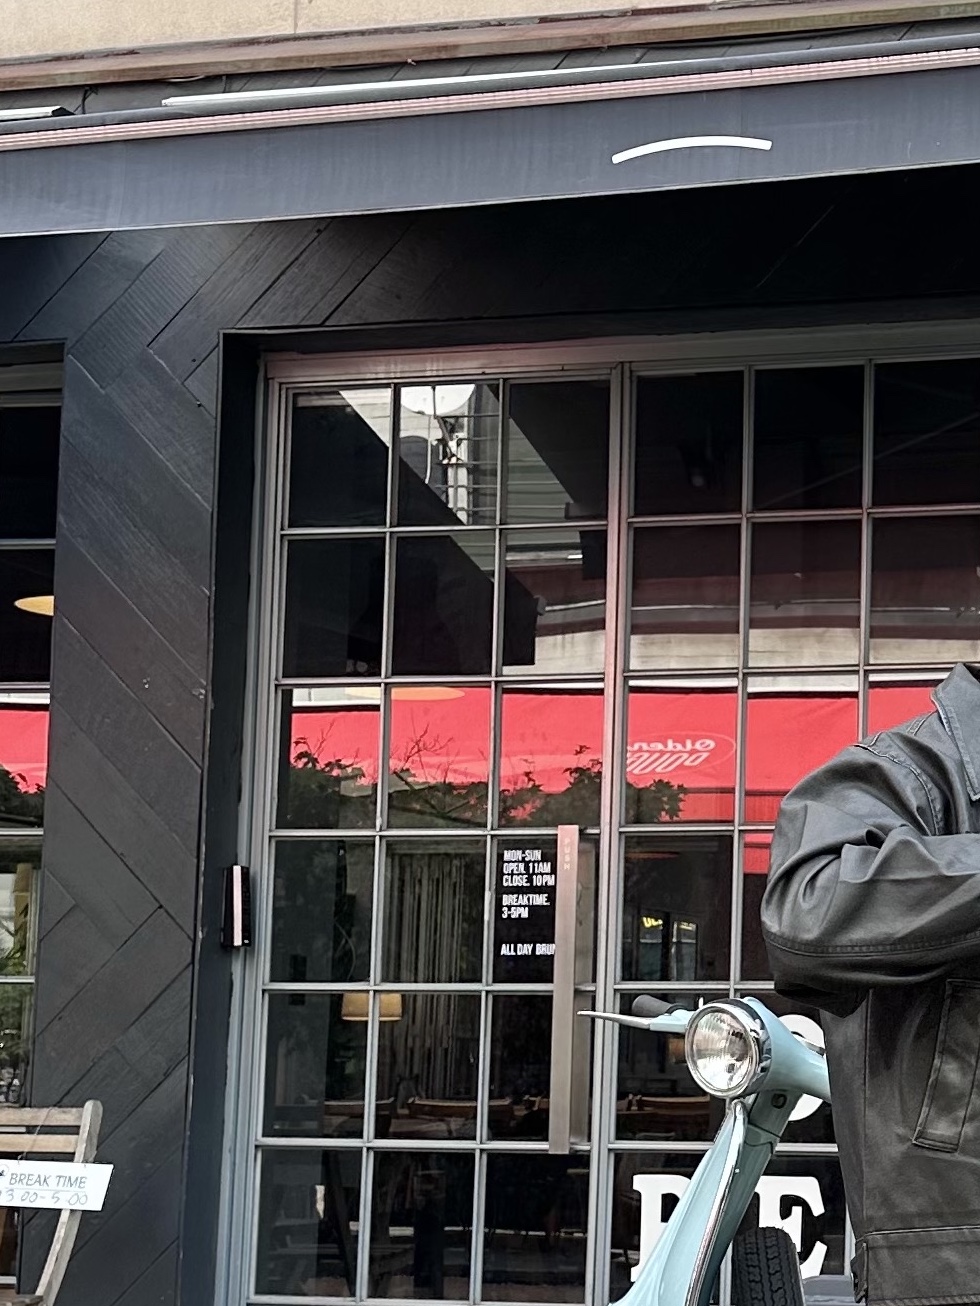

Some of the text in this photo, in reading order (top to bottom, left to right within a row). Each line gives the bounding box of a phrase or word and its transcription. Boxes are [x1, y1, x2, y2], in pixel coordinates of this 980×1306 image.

[503, 850, 542, 861] MON-SUN
[529, 862, 551, 874] 11AM
[532, 874, 555, 886] 10PM
[501, 906, 529, 918] 3-5PM
[500, 943, 516, 956] ALL
[517, 943, 533, 956] DAY
[9, 1172, 88, 1189] BREAK TIME
